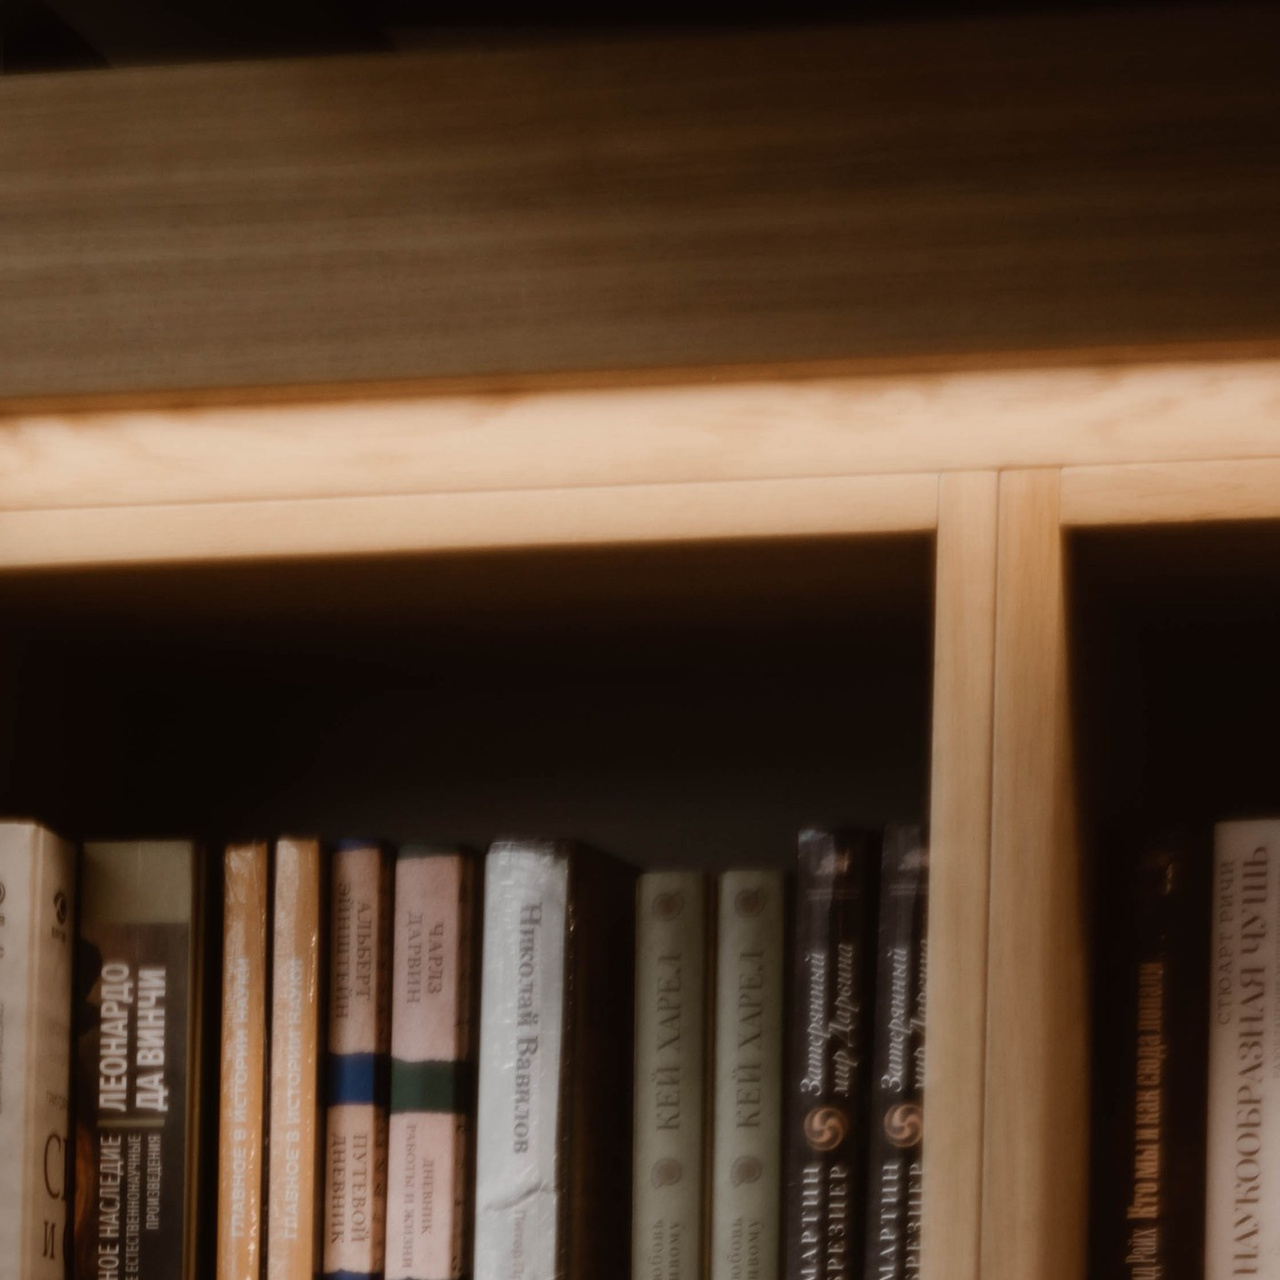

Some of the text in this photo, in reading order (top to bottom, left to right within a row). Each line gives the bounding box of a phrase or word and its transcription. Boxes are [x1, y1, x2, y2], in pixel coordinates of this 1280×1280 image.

[335, 884, 353, 1020] ЭЙНШТЕЙН
[356, 901, 373, 1001] АЛЬБЕРТ
[406, 912, 424, 1005] ДАРВИН
[427, 922, 444, 995] ЧАРЛЗ
[1136, 962, 1164, 1031] попали
[1217, 859, 1234, 1025] СТЮАРТ РИЧИ
[99, 963, 132, 1112] ЛЕОНАРДО
[136, 970, 168, 1112] ДА ВИНЧИ
[513, 902, 544, 1154] Николай Вавилов
[650, 953, 682, 1132] КЕЙ ХАРЕЛ
[732, 950, 764, 1130] КЕЙ ХАРЕЛ
[800, 952, 830, 1096] Затерянный
[880, 946, 910, 1093] Затерянный
[1136, 1034, 1166, 1086] сюда
[1232, 847, 1268, 1277] НАУКООБРАЗНАЯ ЧУШЬ
[232, 958, 250, 1238] ГЛАВНОЕ ИСТОРИИ НАУКИ
[284, 958, 302, 1239] ГЛАВНОЕ ИСТОРИИ НАУКИ
[1135, 1089, 1161, 1124] как
[1135, 1128, 1160, 1141] и
[98, 1135, 123, 1238] НАСЛЕДИЕ
[126, 1135, 141, 1272] ЕСТЕСТВЕННОНАУЧНЫЕ
[146, 1135, 162, 1229] ПРОИЗВЕДЕНИЯ
[330, 1133, 346, 1244] ДНЕВНИК
[351, 1132, 371, 1243] ПУТЕВОЙ
[401, 1124, 417, 1268] РАБОТЫ ЖИЗНИ
[421, 1156, 435, 1235] ДНЕВНИК
[1126, 1182, 1159, 1220] Кто
[1133, 1144, 1160, 1179] мы
[1124, 1228, 1158, 1263] Райх
